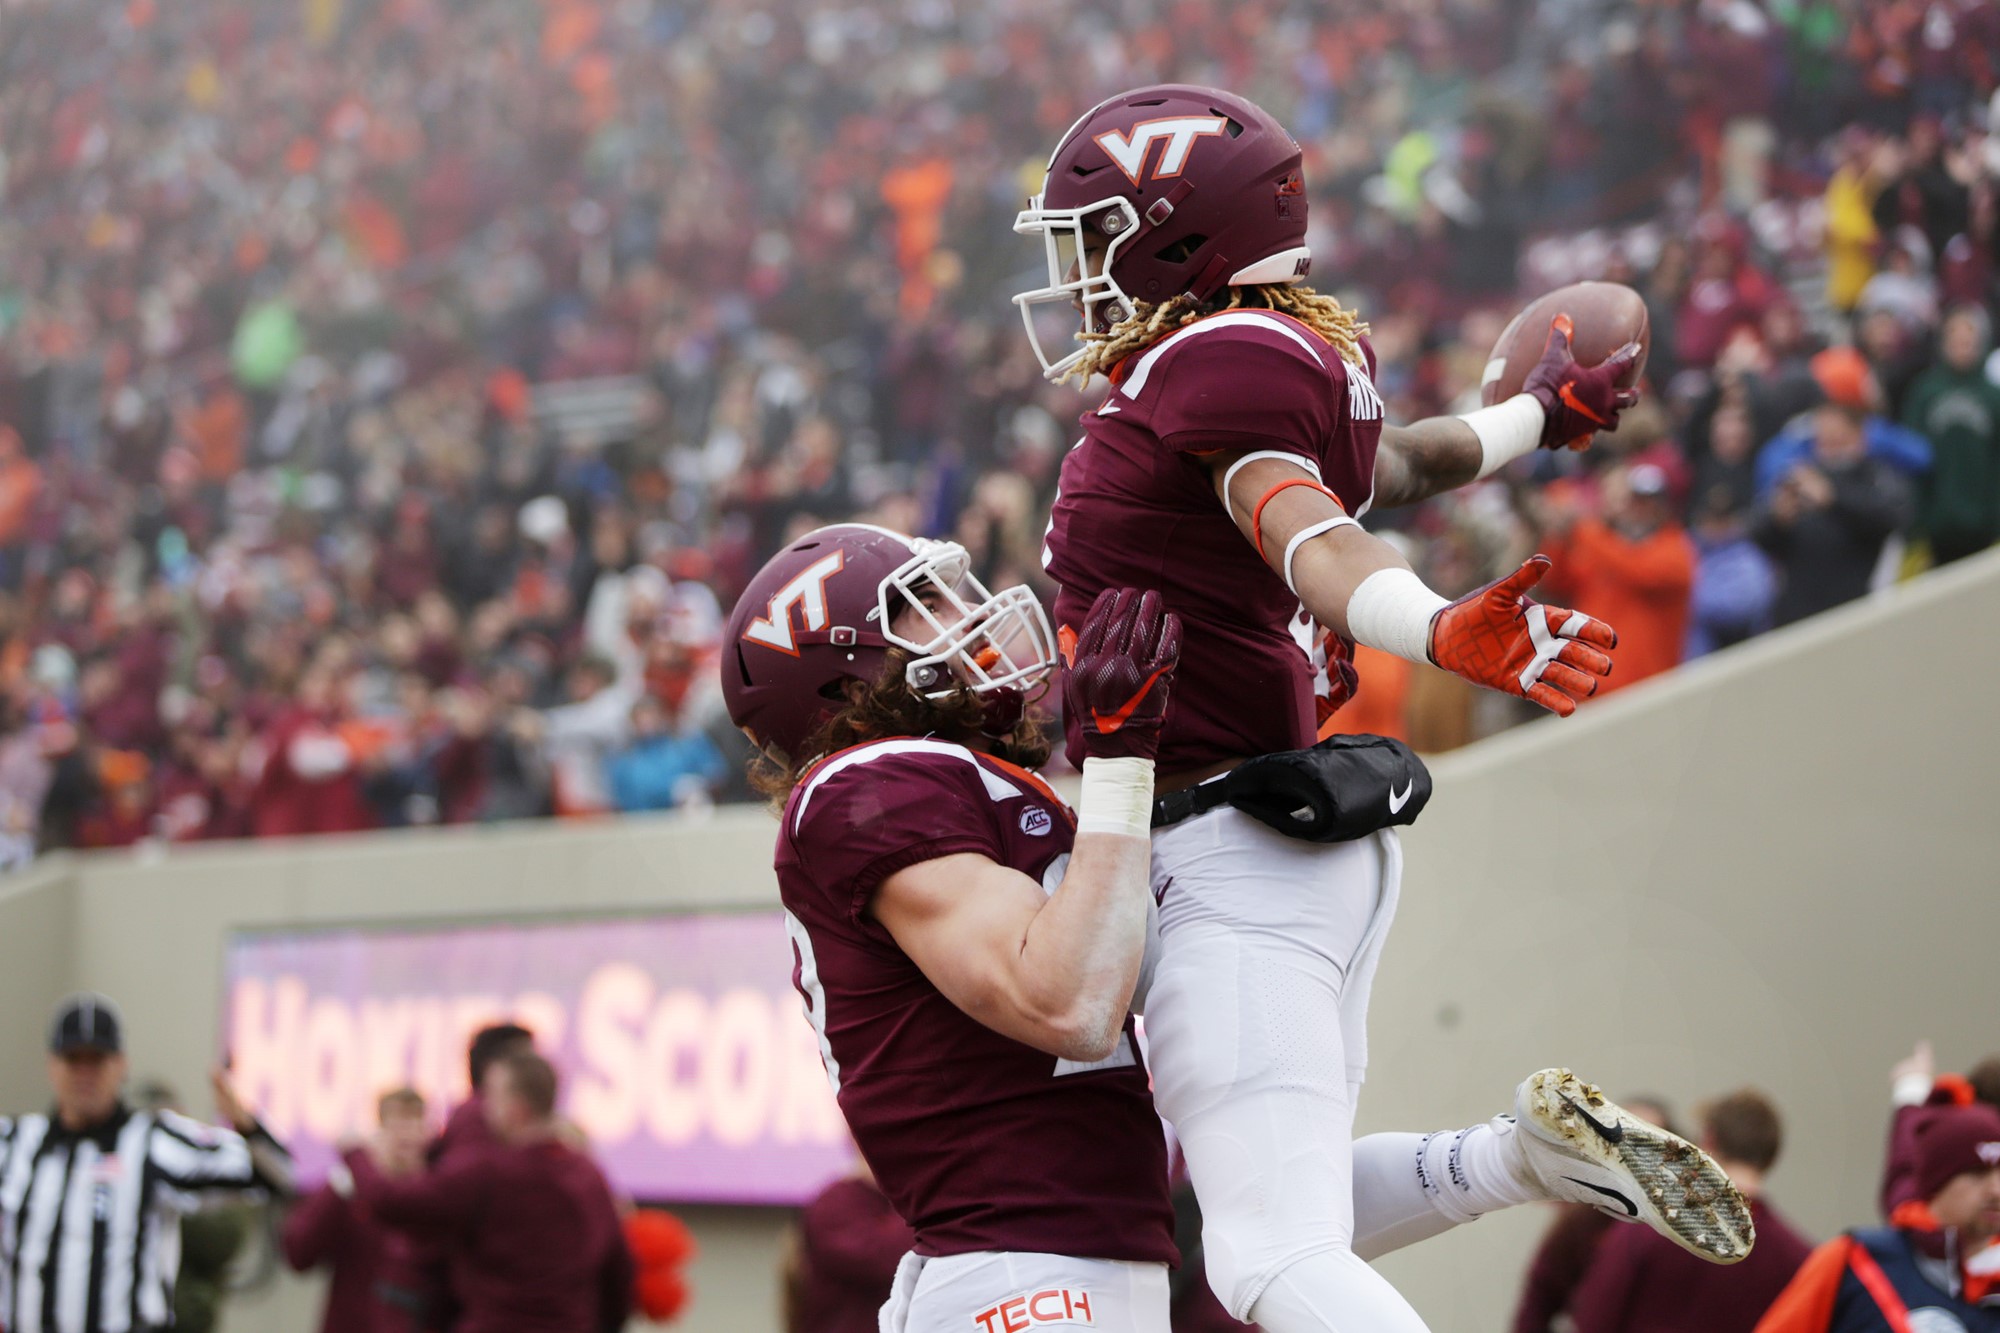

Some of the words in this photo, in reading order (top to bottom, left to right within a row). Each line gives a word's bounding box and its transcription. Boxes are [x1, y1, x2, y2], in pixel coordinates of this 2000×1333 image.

[1092, 116, 1228, 188] VT
[742, 548, 843, 657] VT
[1025, 811, 1048, 829] ACC
[975, 1289, 1092, 1333] TECH
